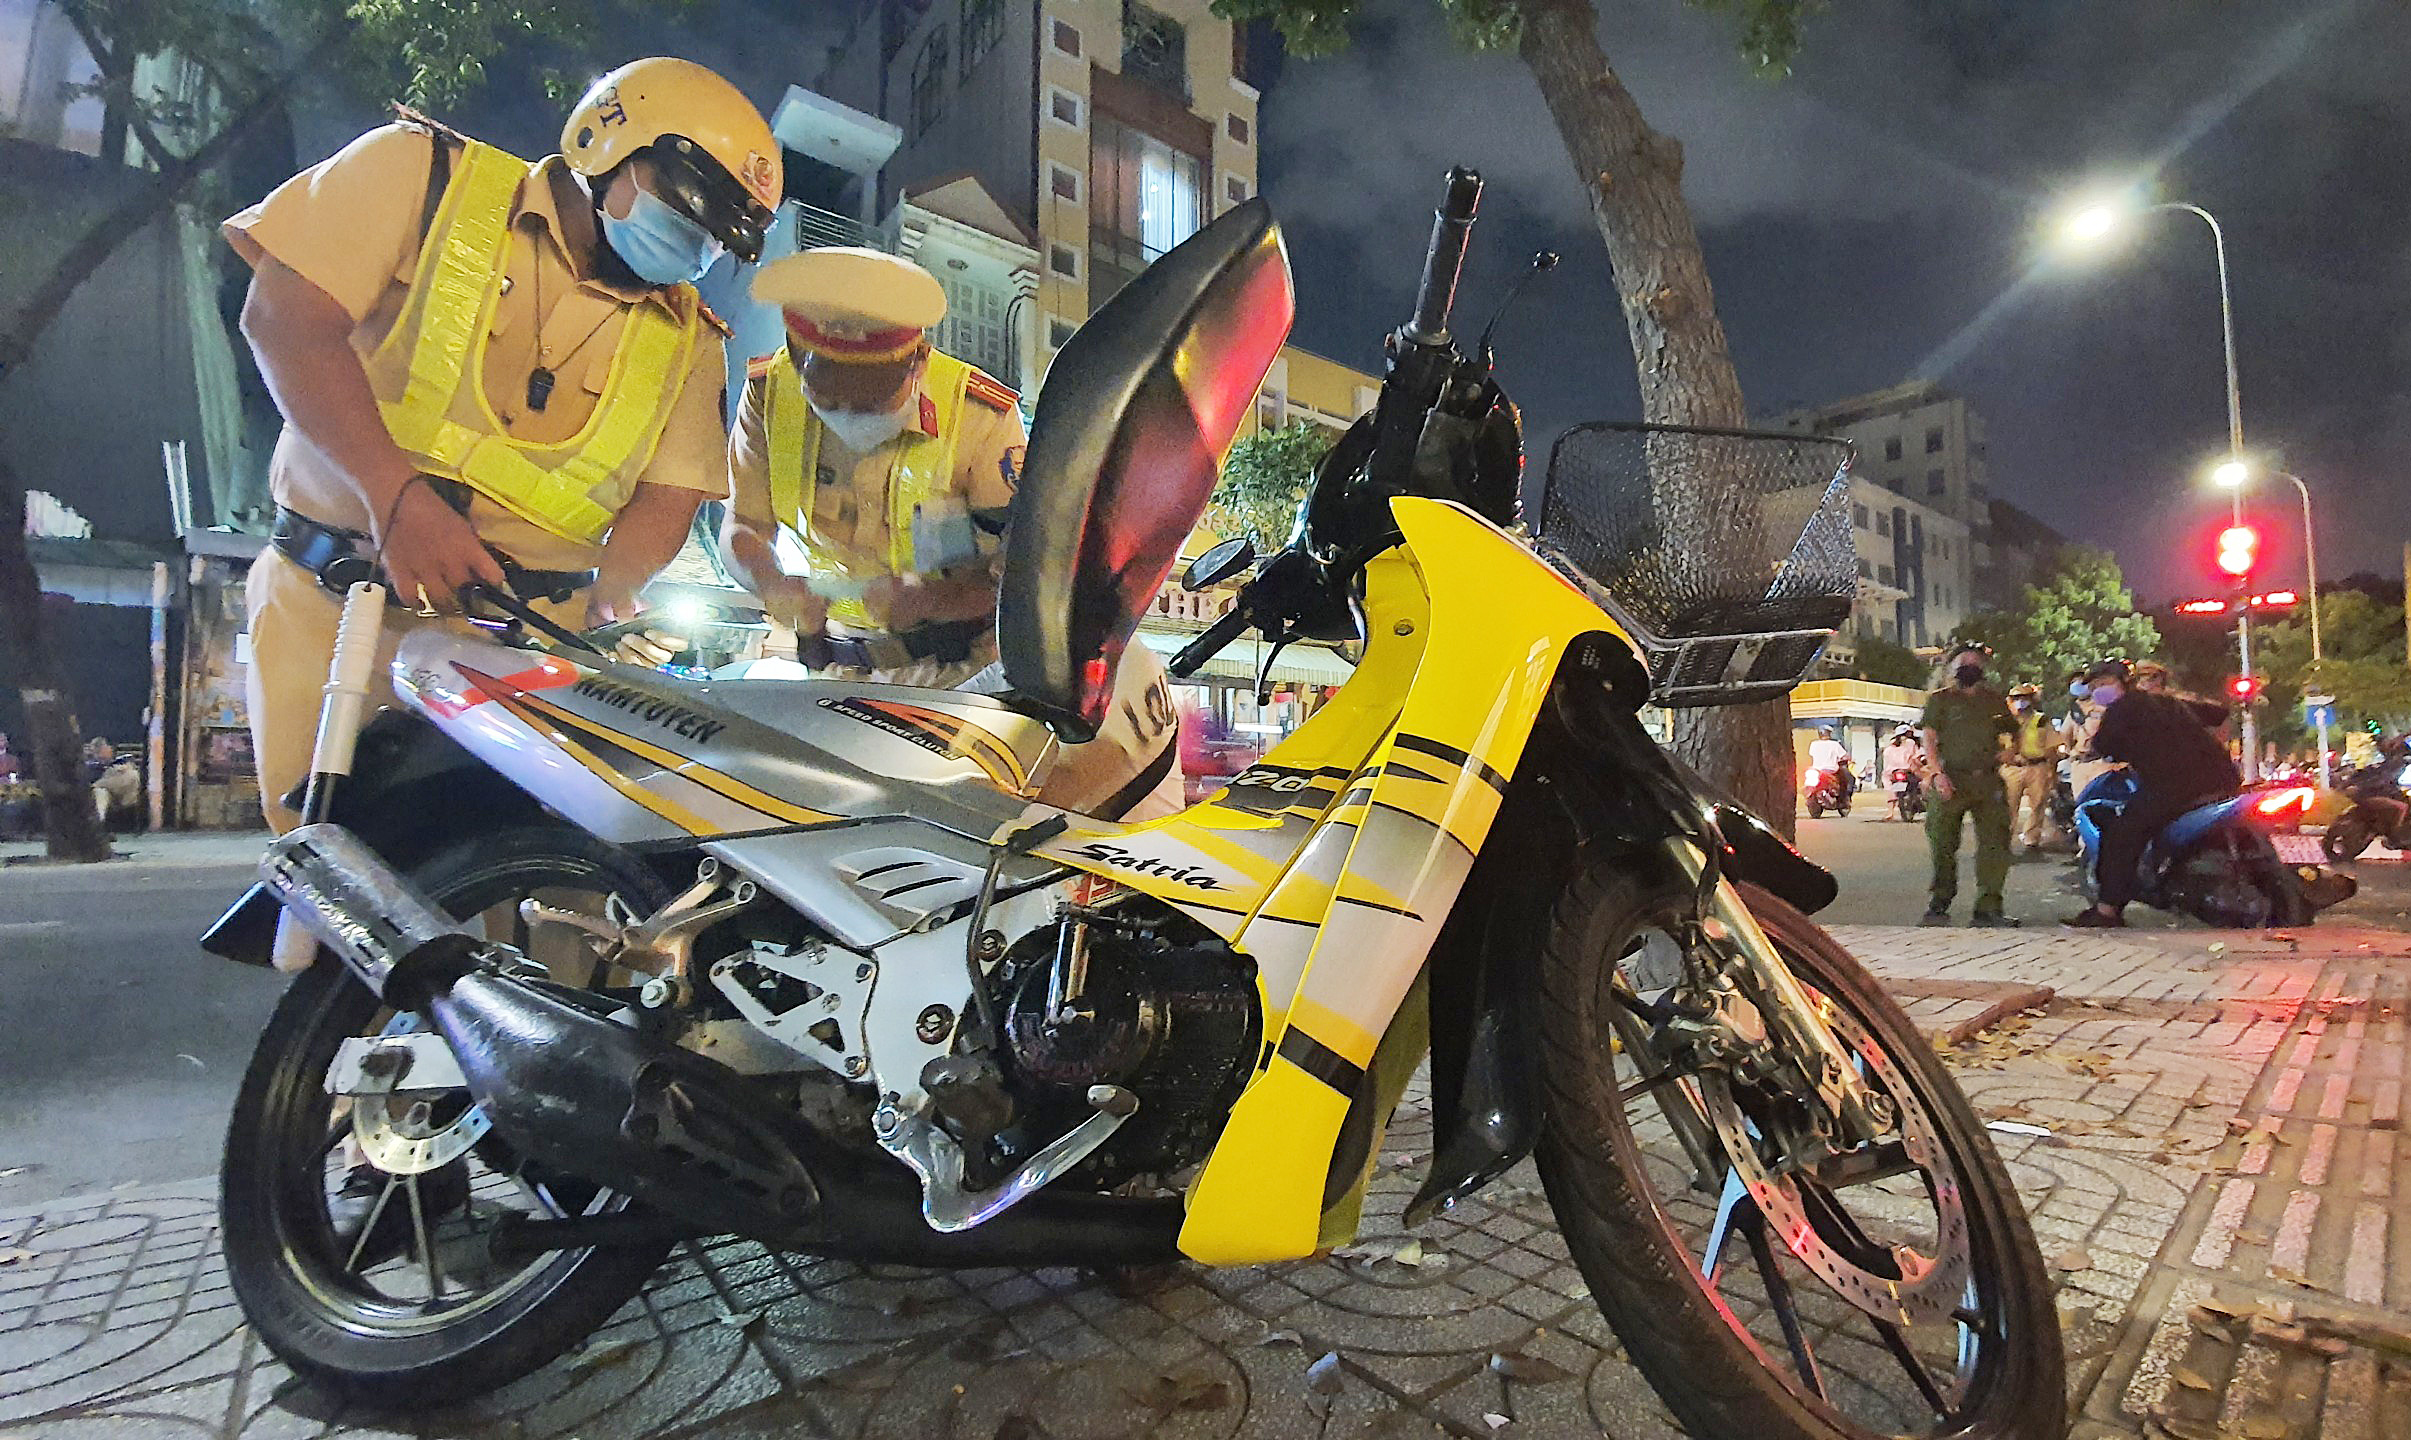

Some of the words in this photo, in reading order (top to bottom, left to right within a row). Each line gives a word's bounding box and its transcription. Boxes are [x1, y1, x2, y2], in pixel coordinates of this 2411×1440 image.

[833, 704, 873, 721] SPEED
[872, 719, 913, 739] SPORT
[911, 735, 958, 760] CLUTCH
[1059, 843, 1235, 892] Satria
